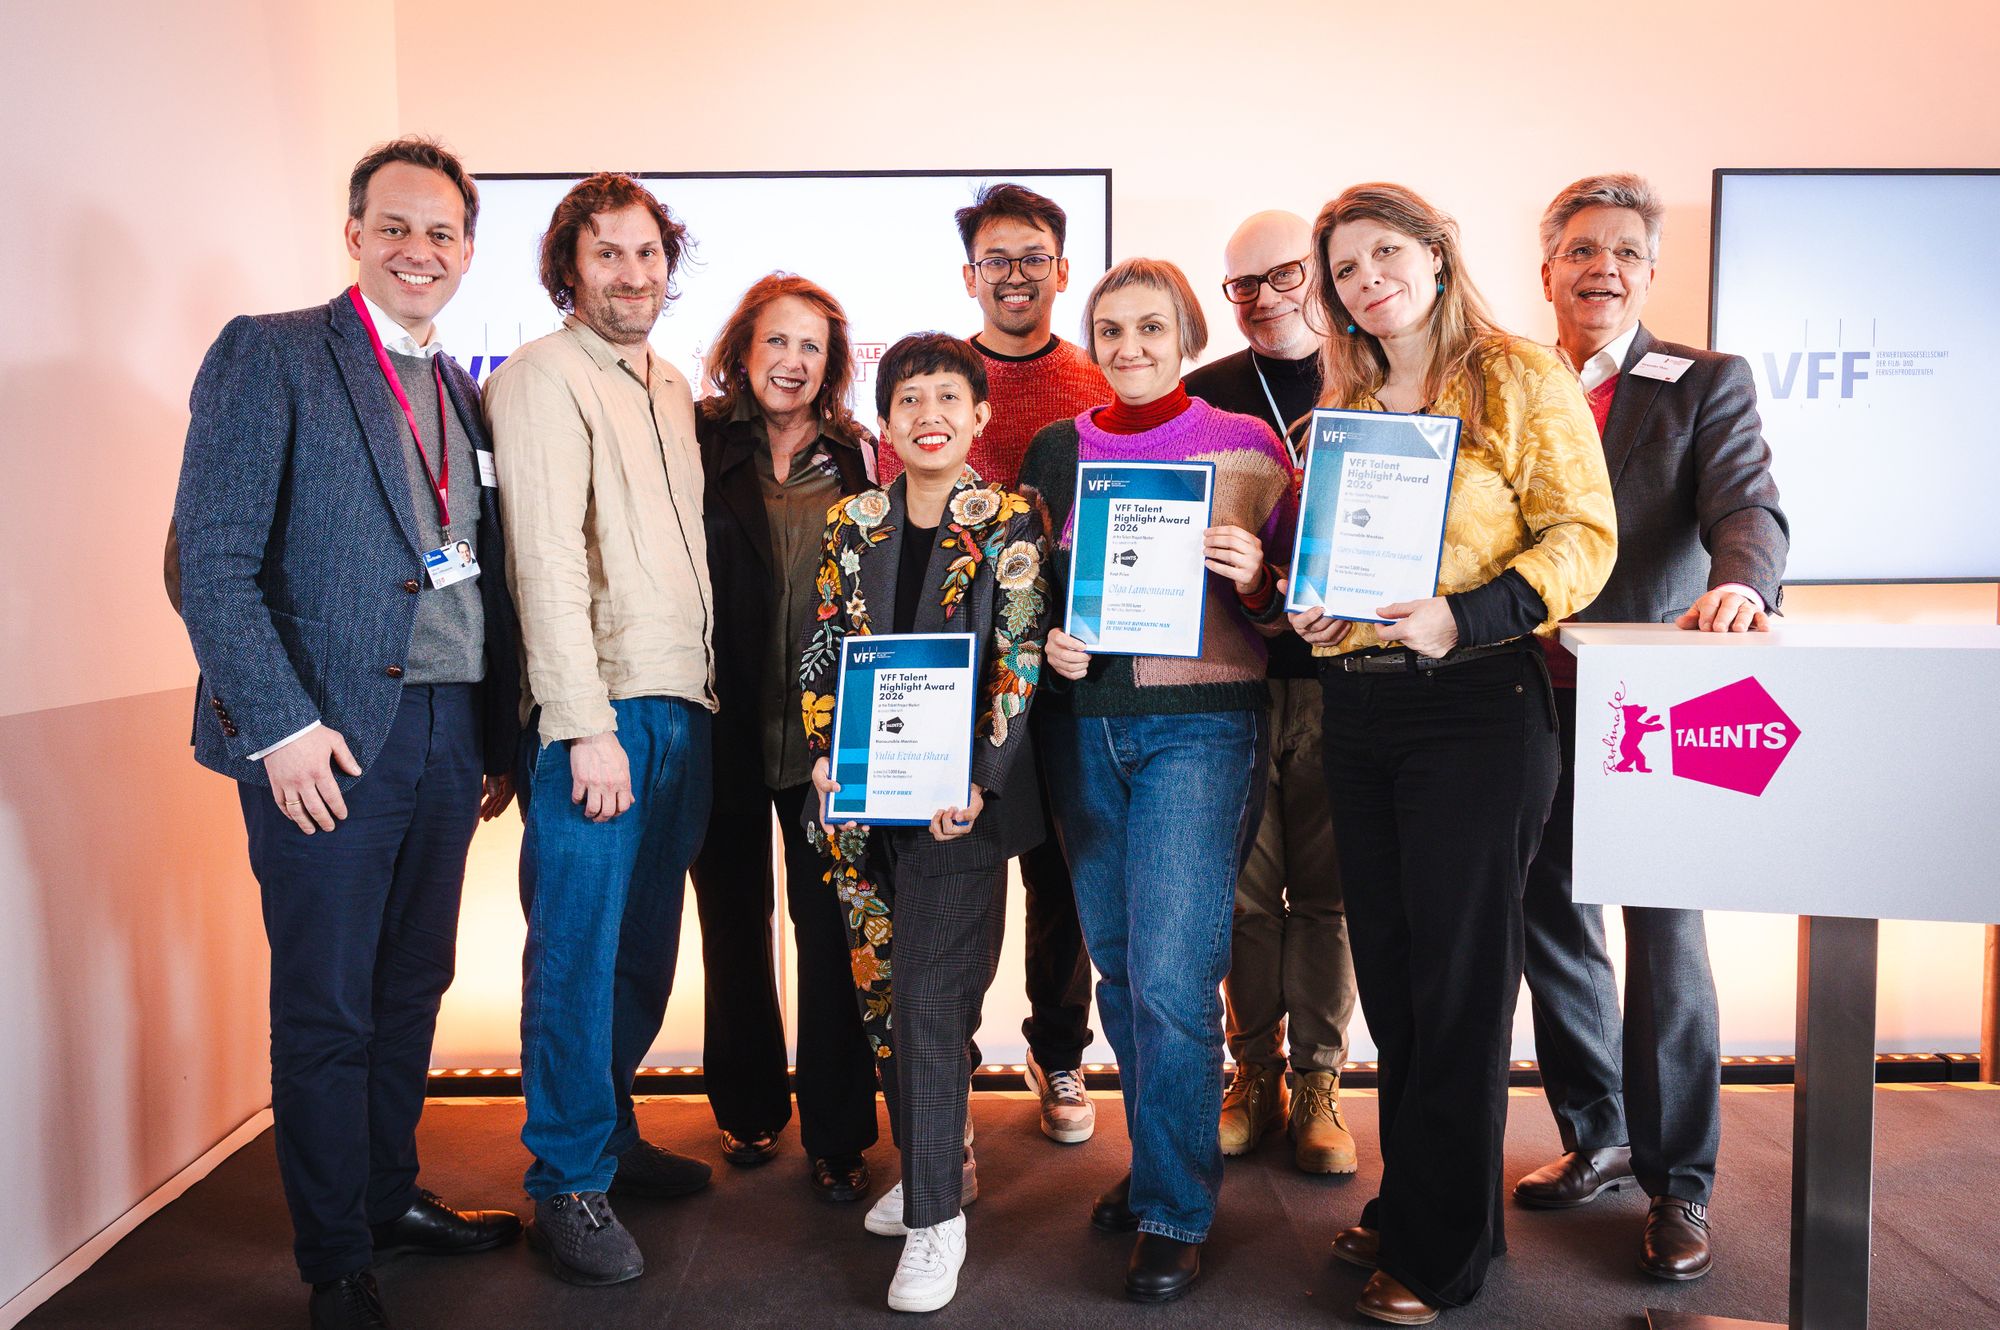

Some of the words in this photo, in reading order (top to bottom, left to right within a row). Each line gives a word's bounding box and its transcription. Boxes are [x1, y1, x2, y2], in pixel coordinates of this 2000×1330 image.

[1762, 352, 1871, 399] VFF
[1322, 431, 1348, 443] VFF
[1350, 458, 1367, 466] VFF
[1369, 459, 1400, 470] Talent
[1348, 469, 1393, 481] Highlight
[1395, 474, 1430, 484] Award
[1088, 480, 1112, 491] VFF
[1346, 480, 1373, 489] 2026
[1115, 504, 1131, 512] VFF
[1134, 504, 1162, 513] Talent
[1114, 514, 1156, 525] Highlight
[1159, 516, 1190, 525] Award
[1113, 524, 1138, 532] 2026
[853, 652, 876, 663] VFF
[900, 673, 928, 681] Talent
[880, 683, 922, 692] Highlight
[924, 682, 955, 690] Award
[879, 692, 904, 700] 2026
[1676, 722, 1787, 750] TALENTS
